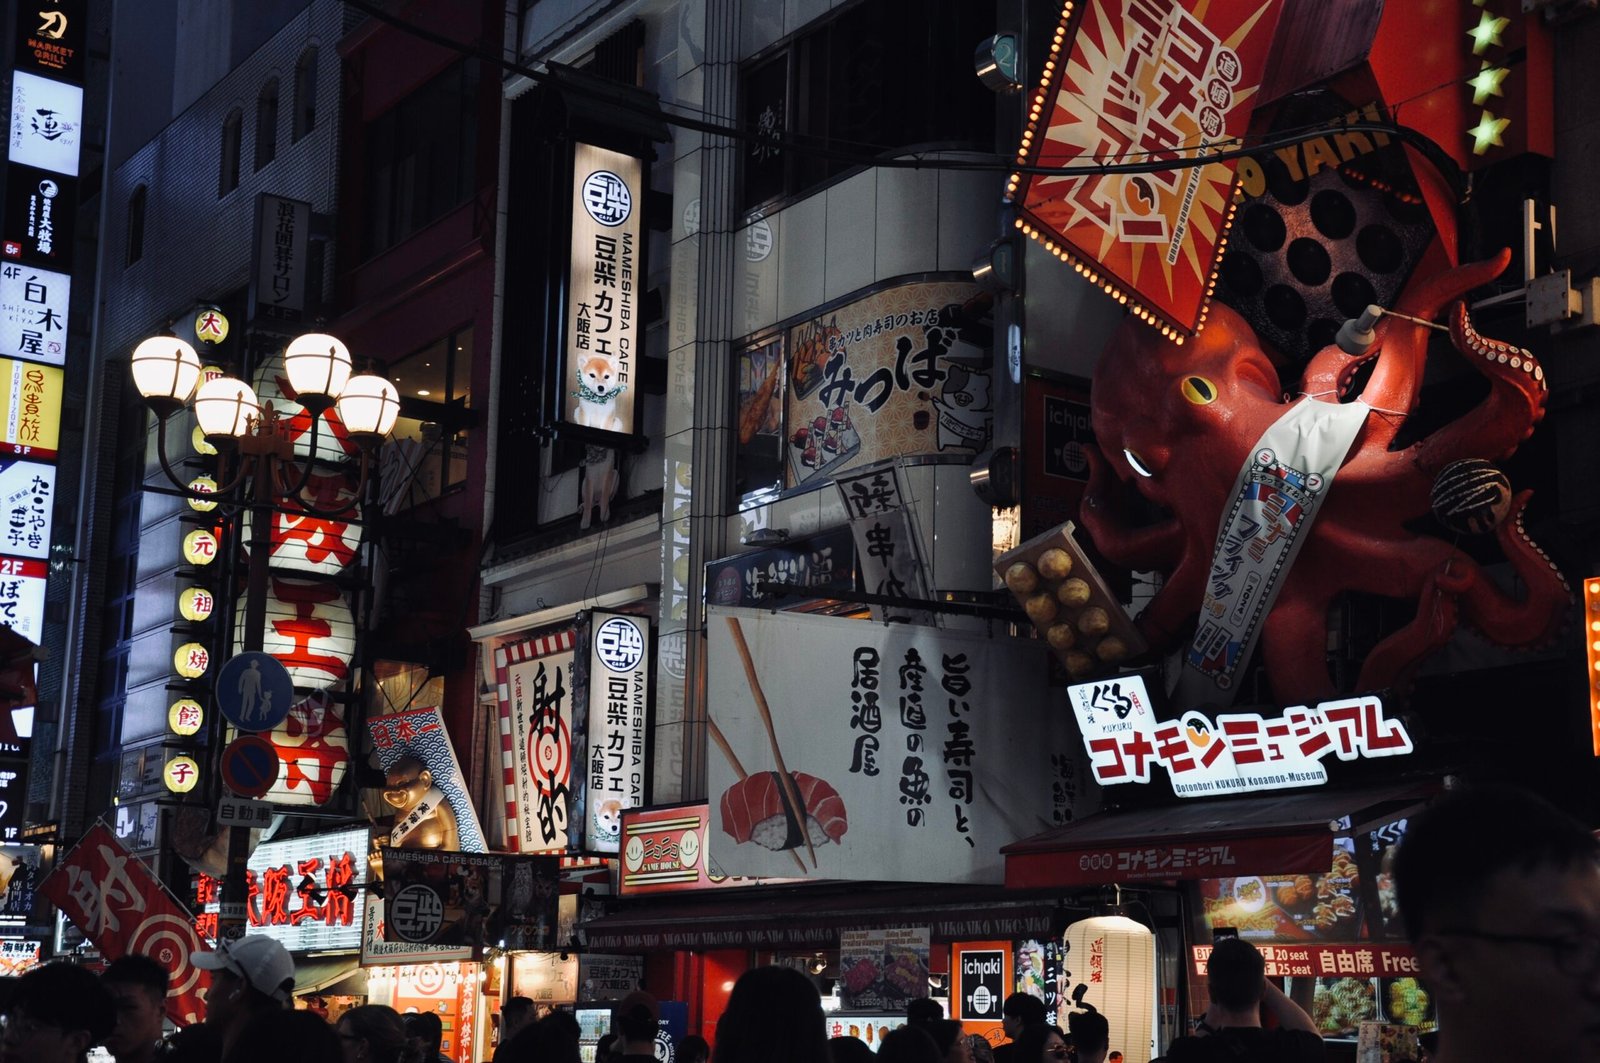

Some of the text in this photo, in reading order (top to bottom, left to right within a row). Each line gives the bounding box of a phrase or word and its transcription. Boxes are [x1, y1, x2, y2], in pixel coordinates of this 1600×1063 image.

[28, 38, 74, 57] MARKET
[34, 50, 67, 65] GRILL
[1199, 50, 1240, 138] 道頓堀
[1168, 138, 1210, 264] Dotoori Konamon-Museum
[5, 244, 18, 255] 5F
[3, 266, 21, 280] 4F
[594, 234, 617, 357] 豆柴カフェ
[617, 232, 632, 384] MAMESHIBA CAFE
[19, 276, 62, 356] 白木屋
[200, 313, 221, 335] 大
[576, 302, 591, 351] 大阪店
[828, 309, 940, 349] 串カツと肉寿司のお店
[819, 328, 957, 413] みつば
[14, 445, 31, 455] 3F
[28, 475, 49, 549] たこやき
[1247, 494, 1287, 563] ミナミ
[1, 560, 24, 574] 2F
[1237, 584, 1254, 615] 2024
[849, 647, 881, 776] 居酒屋
[1091, 683, 1132, 720] くくる
[372, 719, 441, 748] 日本一
[608, 676, 629, 793] 豆柴カフェ
[630, 671, 644, 808] MAMESHIBA CAF
[899, 648, 931, 827] 産直の魚の
[1089, 703, 1406, 778] コナモンミュージアム
[1102, 721, 1132, 733] KUKURU
[529, 661, 571, 846] 射的
[591, 745, 605, 791] 大阪店
[1176, 771, 1324, 793] Dotonbori KUKURU Konamon-Museum
[220, 803, 270, 821] 自動車
[4, 827, 17, 838] 1F
[386, 851, 500, 867] MAMESHIBA CAFE OSAKA
[644, 836, 679, 860] ニコニコ
[1117, 846, 1237, 871] コナモンミュージアム
[642, 861, 680, 872] GAME HOUSE
[10, 880, 23, 911] 専門店
[1275, 949, 1288, 961] 20
[1290, 951, 1310, 962] seat
[1278, 964, 1290, 976] 25
[1292, 964, 1312, 976] seat
[1319, 949, 1421, 974] 自由席 Free
[589, 966, 639, 979] 豆柴カフェ
[600, 980, 630, 990] 大阪店
